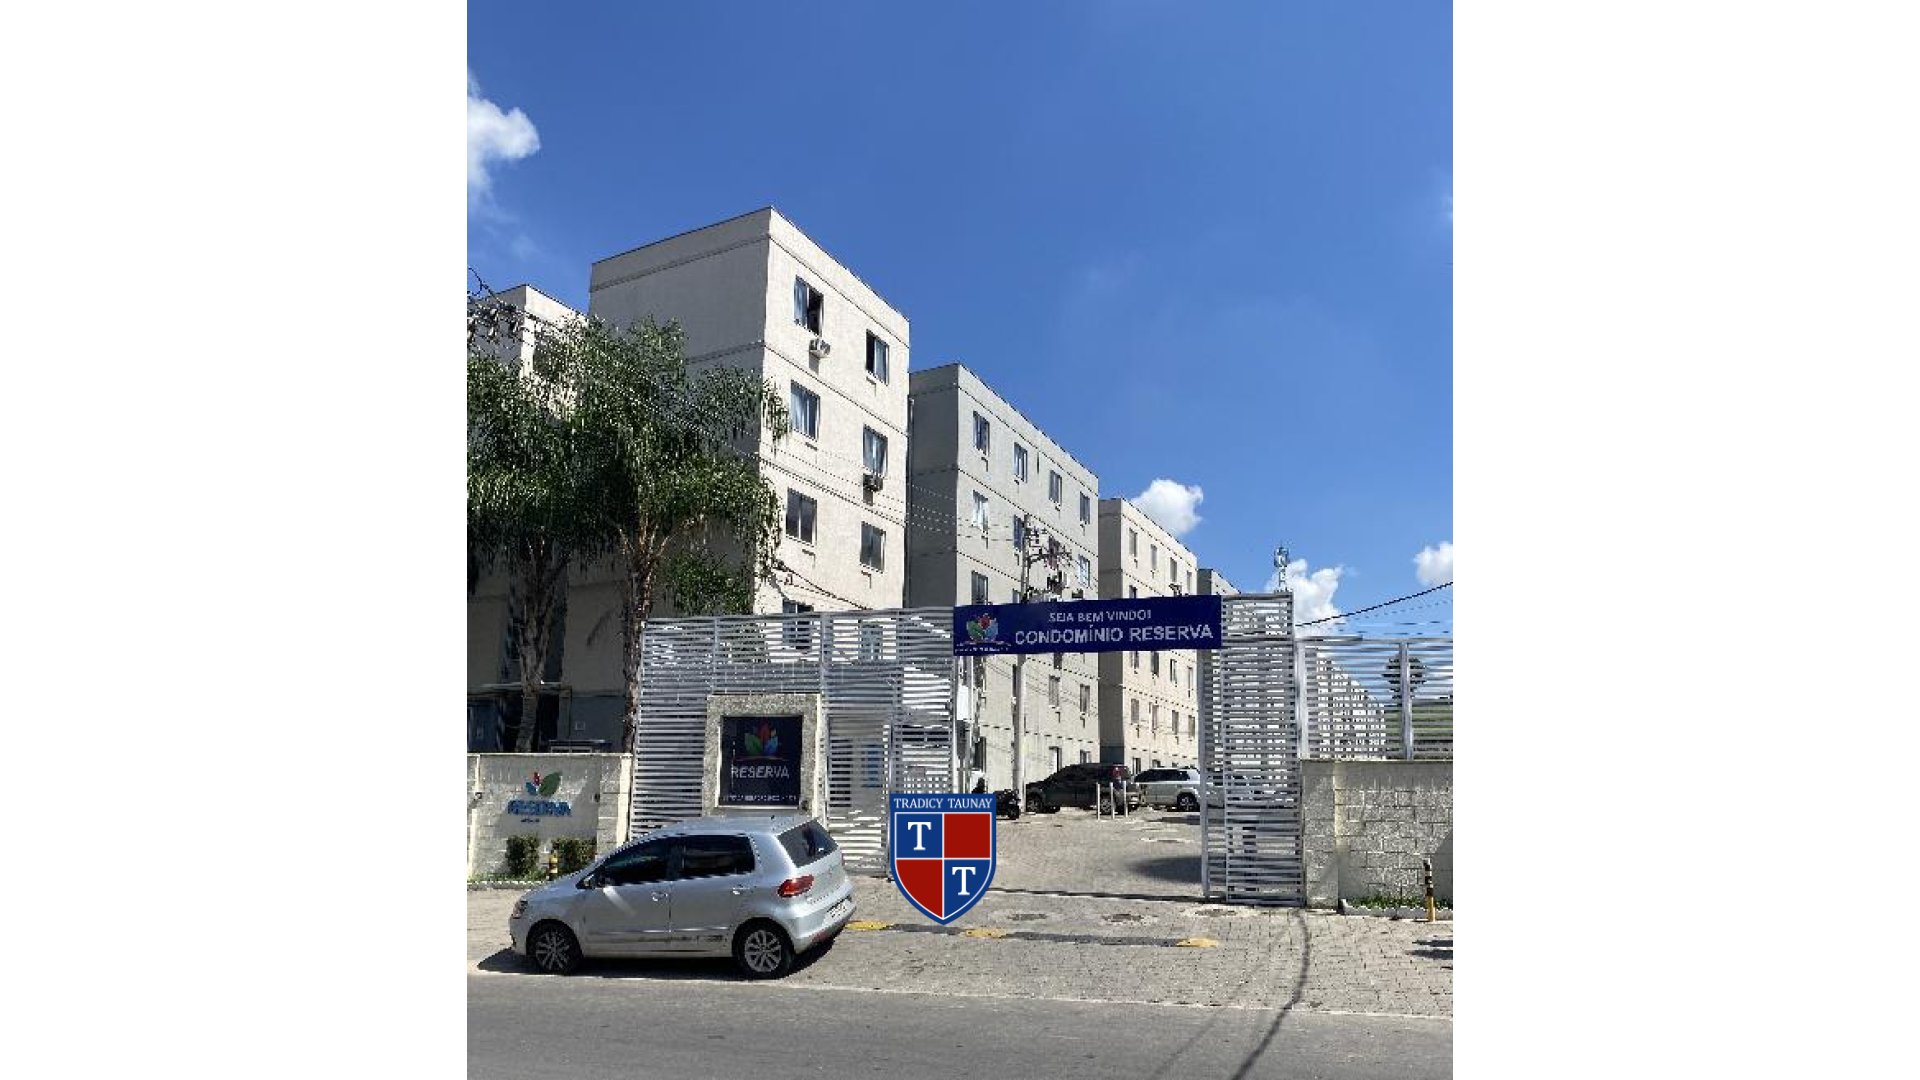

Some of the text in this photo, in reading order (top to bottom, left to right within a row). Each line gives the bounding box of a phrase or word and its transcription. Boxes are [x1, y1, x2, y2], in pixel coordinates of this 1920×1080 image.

[1049, 609, 1152, 622] SEJA BEM VINDO!
[1015, 624, 1213, 645] CONDOMÍNIO RESERVA
[731, 765, 789, 778] RESERVA
